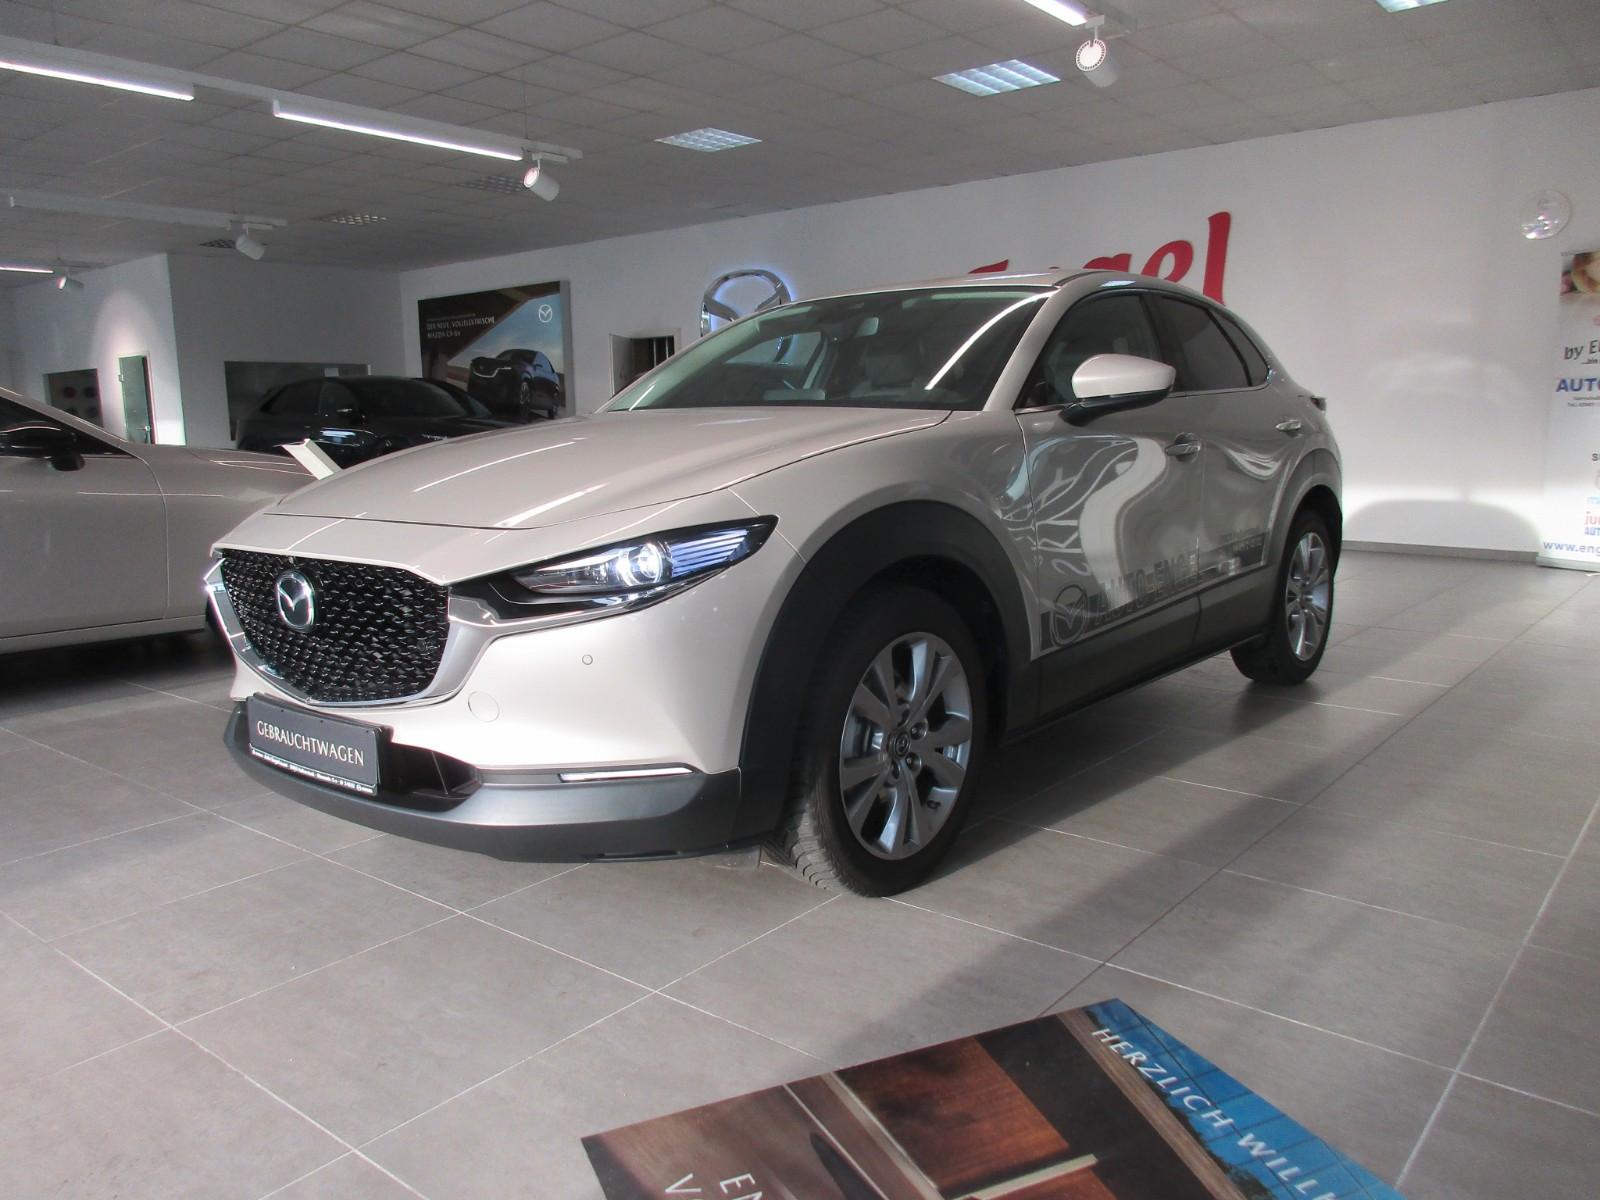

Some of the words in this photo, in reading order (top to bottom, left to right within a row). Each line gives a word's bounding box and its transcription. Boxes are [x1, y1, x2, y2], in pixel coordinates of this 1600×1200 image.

[1564, 346, 1584, 360] by
[256, 720, 364, 767] GEBRAUCHTWAGEN
[1091, 1028, 1234, 1128] HERZLICH
[1237, 1133, 1337, 1200] WILL
